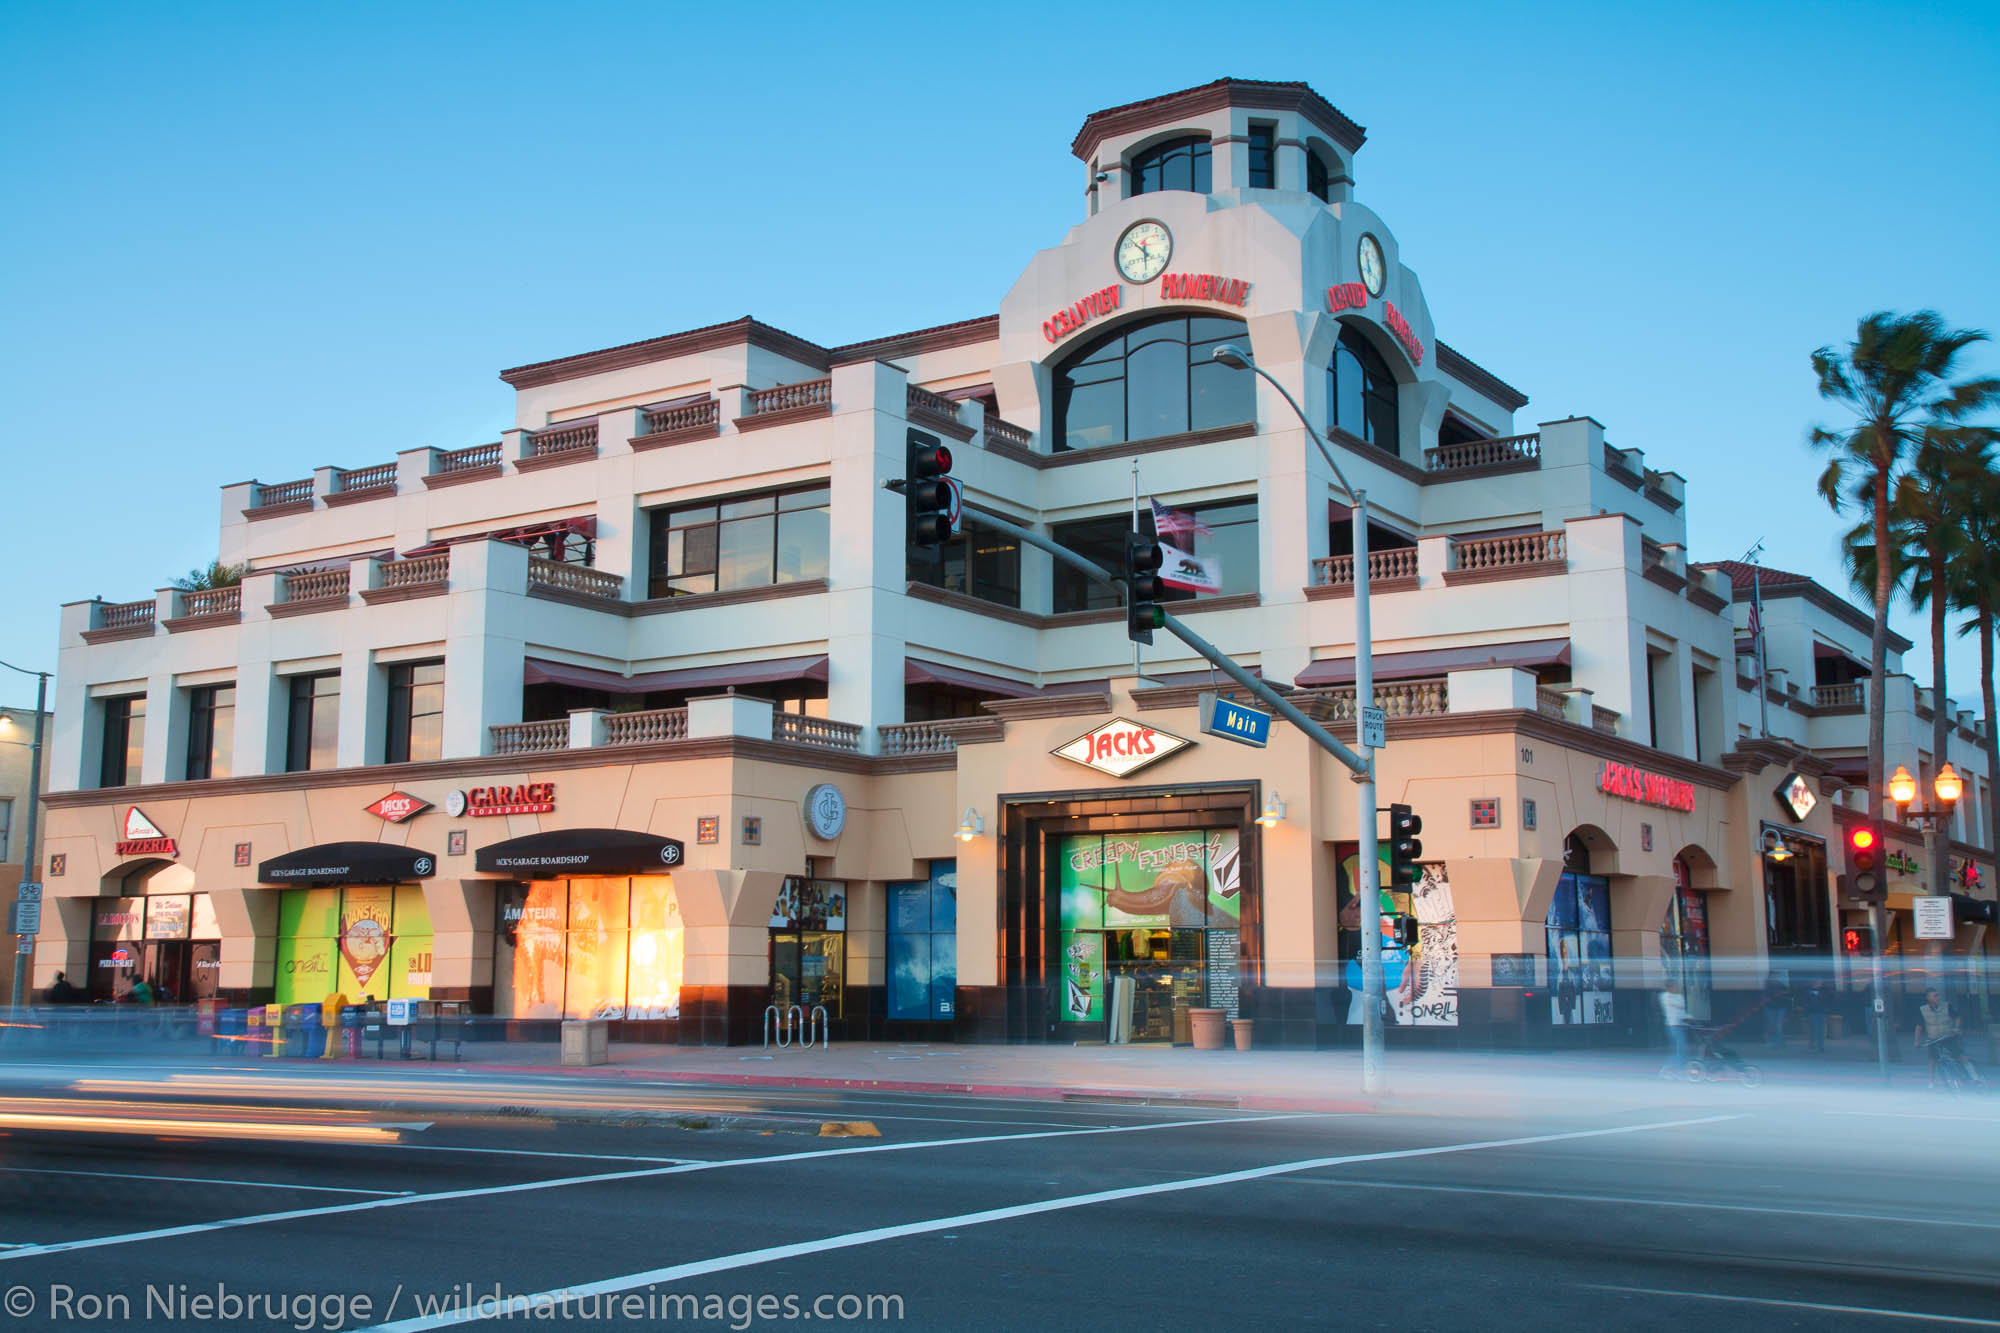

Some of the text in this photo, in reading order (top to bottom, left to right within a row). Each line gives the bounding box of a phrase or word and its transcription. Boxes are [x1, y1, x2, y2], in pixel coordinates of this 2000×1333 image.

[1042, 272, 1253, 343] OCEANVIEW PROMENADE
[1226, 710, 1258, 735] Main
[1364, 711, 1383, 721] TRUCK
[1364, 720, 1384, 732] ROUTE
[1084, 726, 1156, 764] JACK'S
[1520, 748, 1534, 764] 101
[467, 783, 556, 808] GARAGE
[380, 798, 411, 815] JACK'S
[469, 804, 549, 817] BOARDSHOP
[115, 839, 176, 856] PIZZERIA
[1070, 840, 1139, 871] CREEPY
[512, 857, 540, 866] GARAGE
[540, 855, 590, 865] BOARDSHOP
[284, 869, 306, 877] GARAGE
[307, 866, 350, 876] BOARDSHOP
[344, 905, 390, 932] VANS PRO
